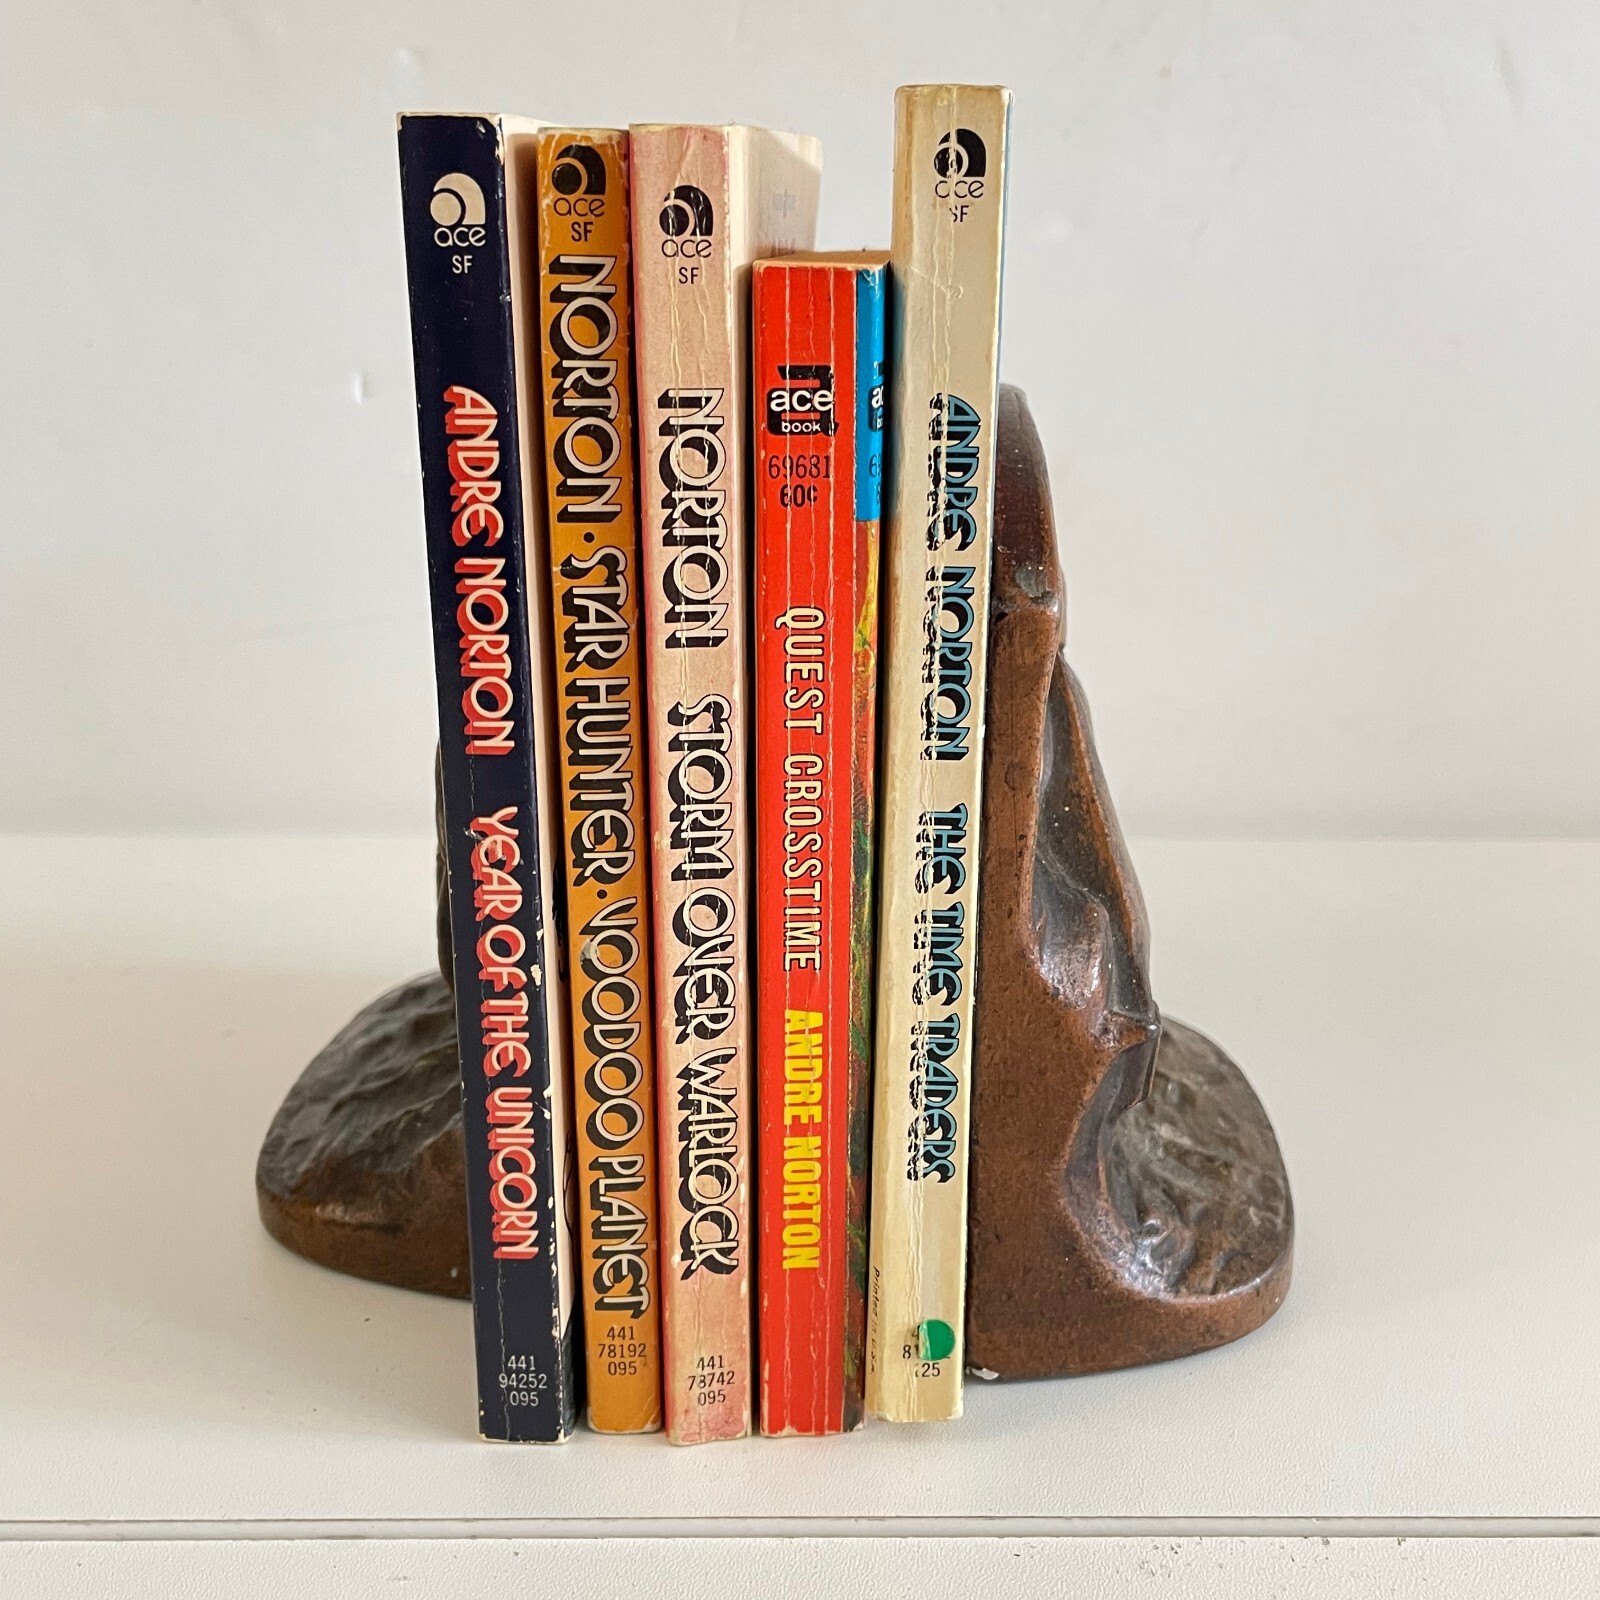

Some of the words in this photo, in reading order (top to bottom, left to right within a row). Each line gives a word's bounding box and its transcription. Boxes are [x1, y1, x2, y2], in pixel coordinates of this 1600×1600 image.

[433, 226, 486, 248] ace
[554, 197, 606, 218] ace
[570, 221, 594, 242] SF
[661, 238, 712, 259] ace
[451, 254, 473, 274] SF
[678, 266, 700, 285] SF
[549, 254, 623, 524] NORTON
[769, 389, 834, 412] ace
[781, 421, 822, 433] book
[443, 384, 505, 547] ANDRE
[768, 454, 832, 480] 69681
[779, 484, 818, 508] 60¢
[925, 391, 982, 552] ANDRE
[657, 388, 729, 649] NORTON
[559, 545, 631, 673] STAR
[454, 557, 516, 756] NORTON
[775, 605, 826, 736] QUEST
[919, 565, 977, 761] NORTON
[565, 676, 636, 887] HUNTER
[666, 693, 735, 882] STORM
[470, 806, 524, 922] YEAR
[782, 754, 826, 972] CROSSTIME
[914, 802, 968, 895] THE
[476, 923, 529, 992] OF
[672, 886, 736, 1045] OVER
[911, 900, 966, 1006] TIME
[480, 991, 532, 1078] THE
[578, 896, 645, 1151] VOODOO
[783, 1008, 824, 1126] ANDRE
[906, 1012, 961, 1184] TRADERS
[485, 1087, 540, 1260] UNICORN
[675, 1046, 740, 1281] WARLOCK
[782, 1135, 822, 1270] NORTON
[588, 1154, 650, 1320] PLANET
[507, 1355, 535, 1372] 441
[597, 1342, 647, 1359] 78192
[606, 1325, 635, 1342] 441
[607, 1360, 638, 1377] 095
[696, 1355, 725, 1372] 441
[498, 1372, 548, 1390] 94252
[509, 1390, 540, 1407] 095
[687, 1370, 736, 1391] 78742
[697, 1389, 727, 1407] 095
